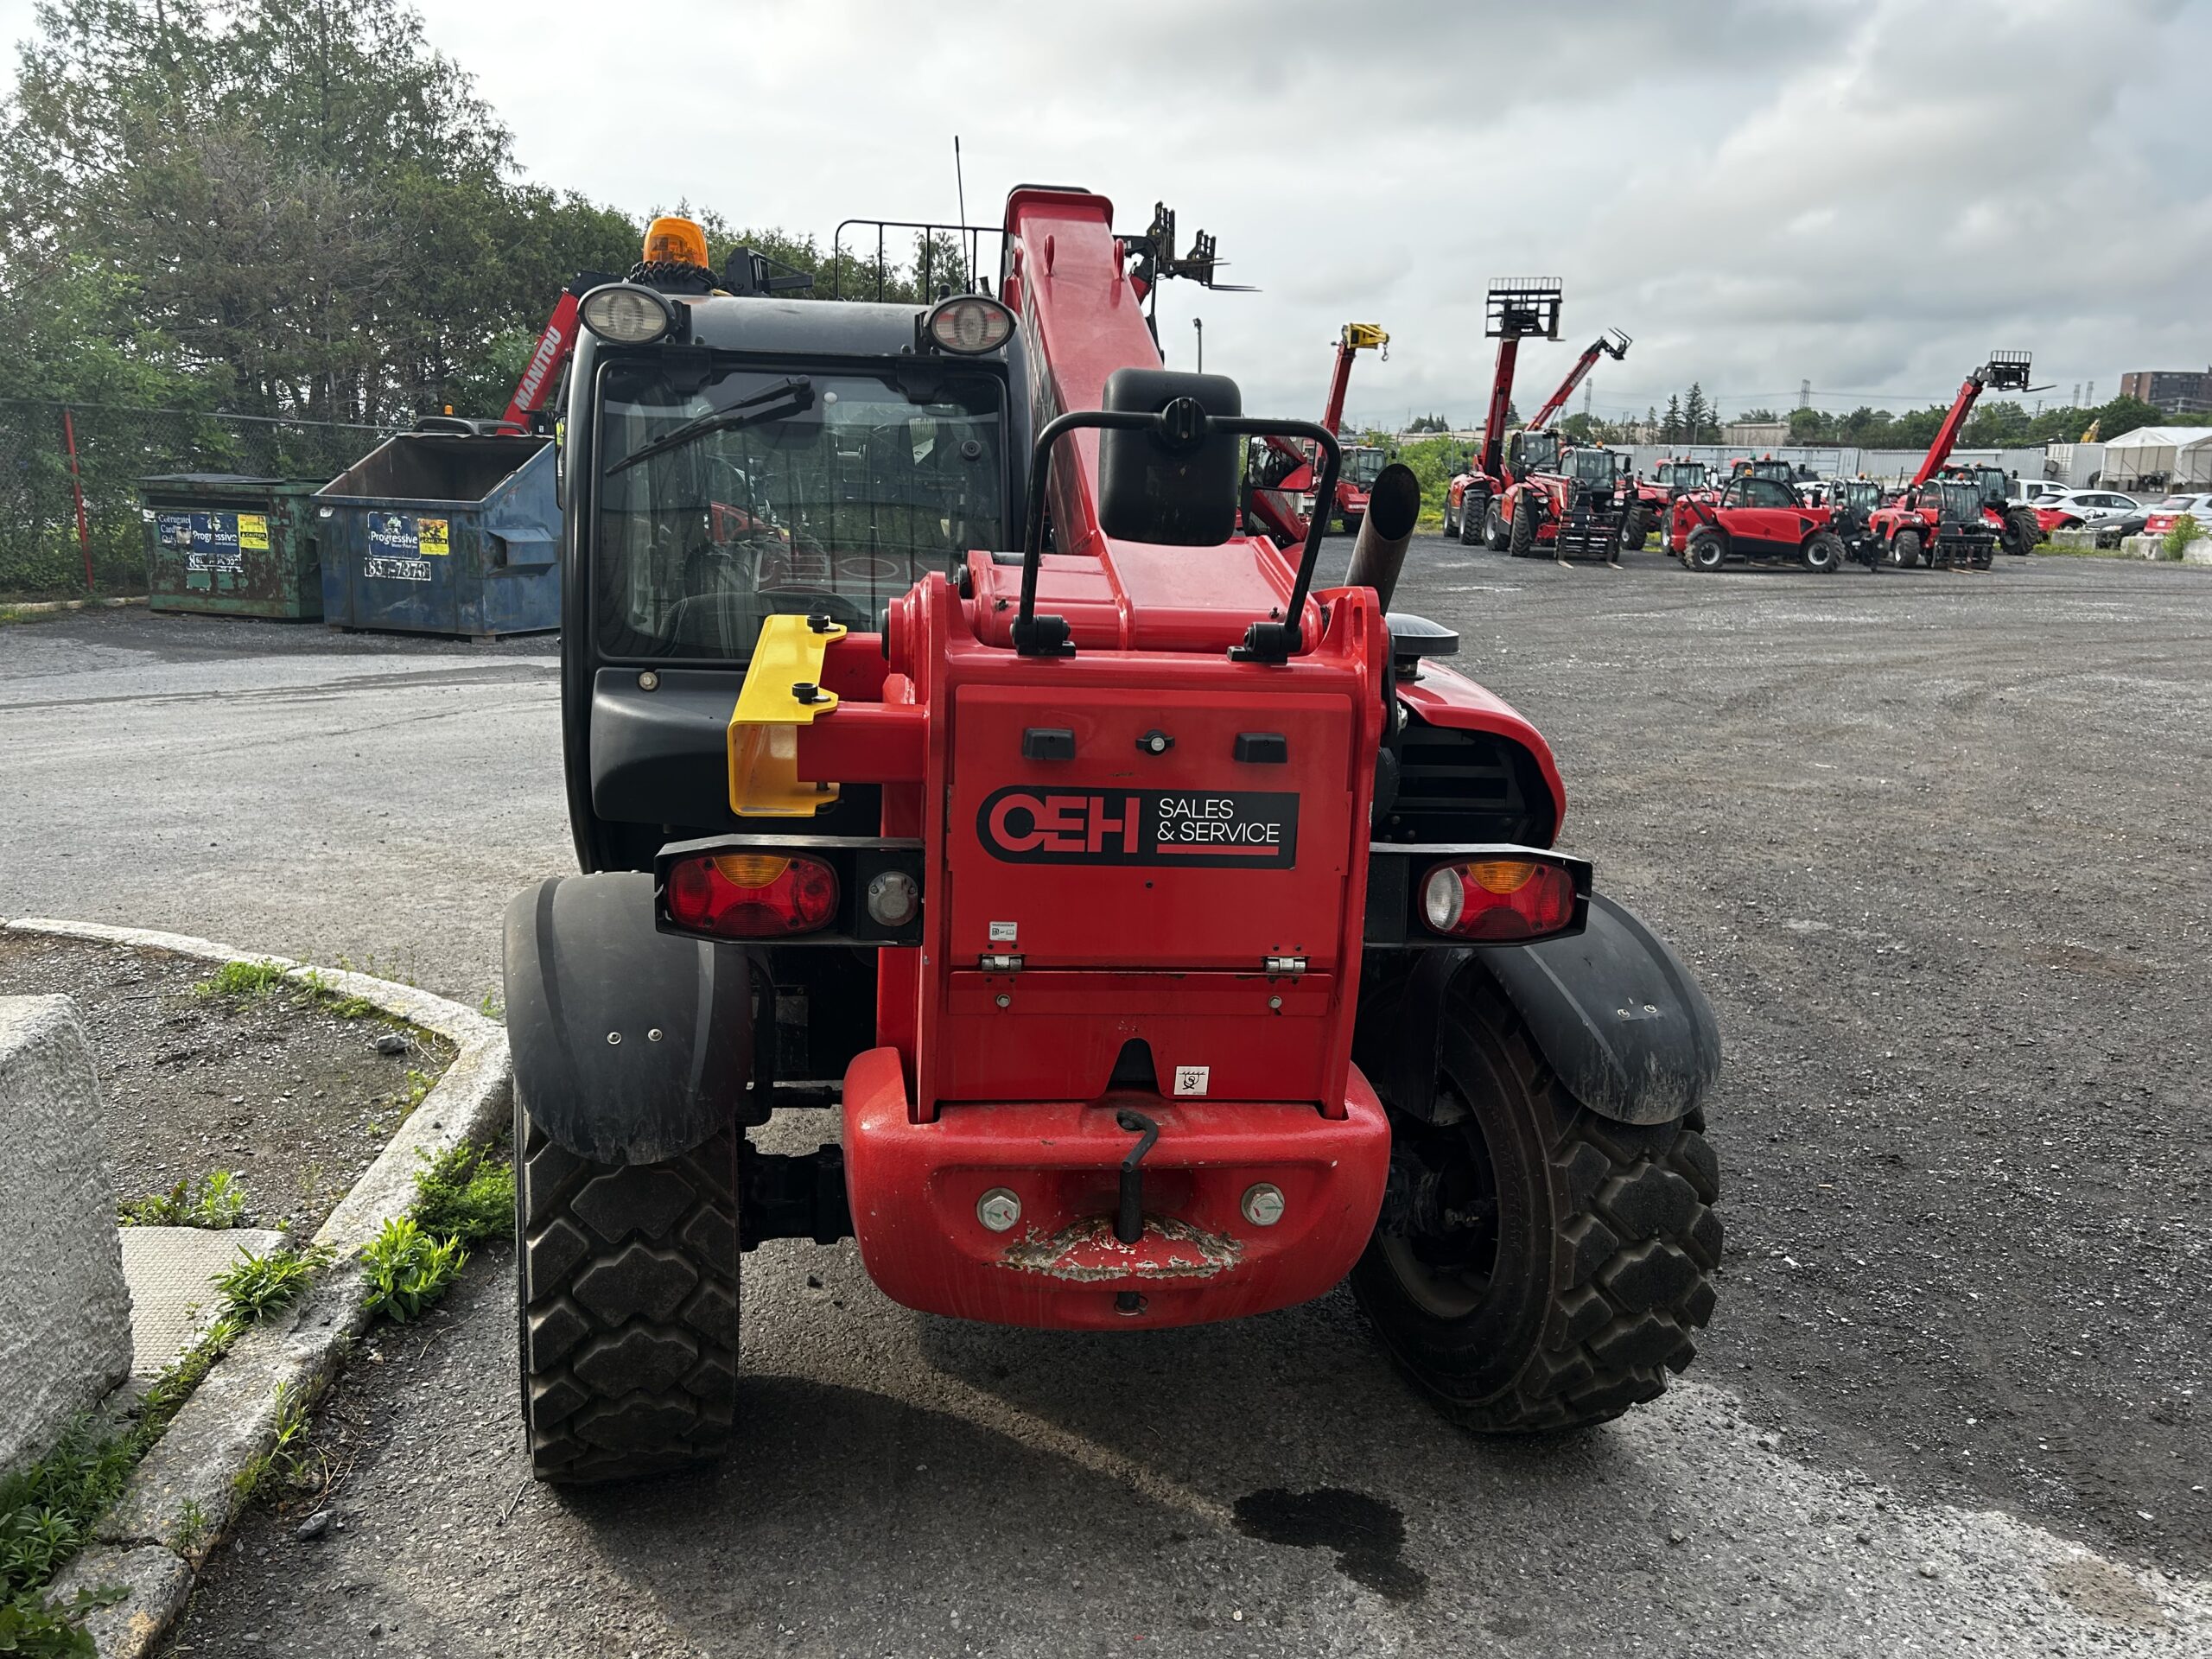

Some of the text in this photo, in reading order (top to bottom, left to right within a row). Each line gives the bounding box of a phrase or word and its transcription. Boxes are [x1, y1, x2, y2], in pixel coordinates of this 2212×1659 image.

[514, 326, 562, 410] MANITOU
[193, 531, 238, 543] Progrssive
[371, 531, 418, 545] Progressive
[1159, 798, 1234, 819] SALES
[989, 793, 1141, 854] OEH
[1157, 822, 1281, 843] & SERVICE
